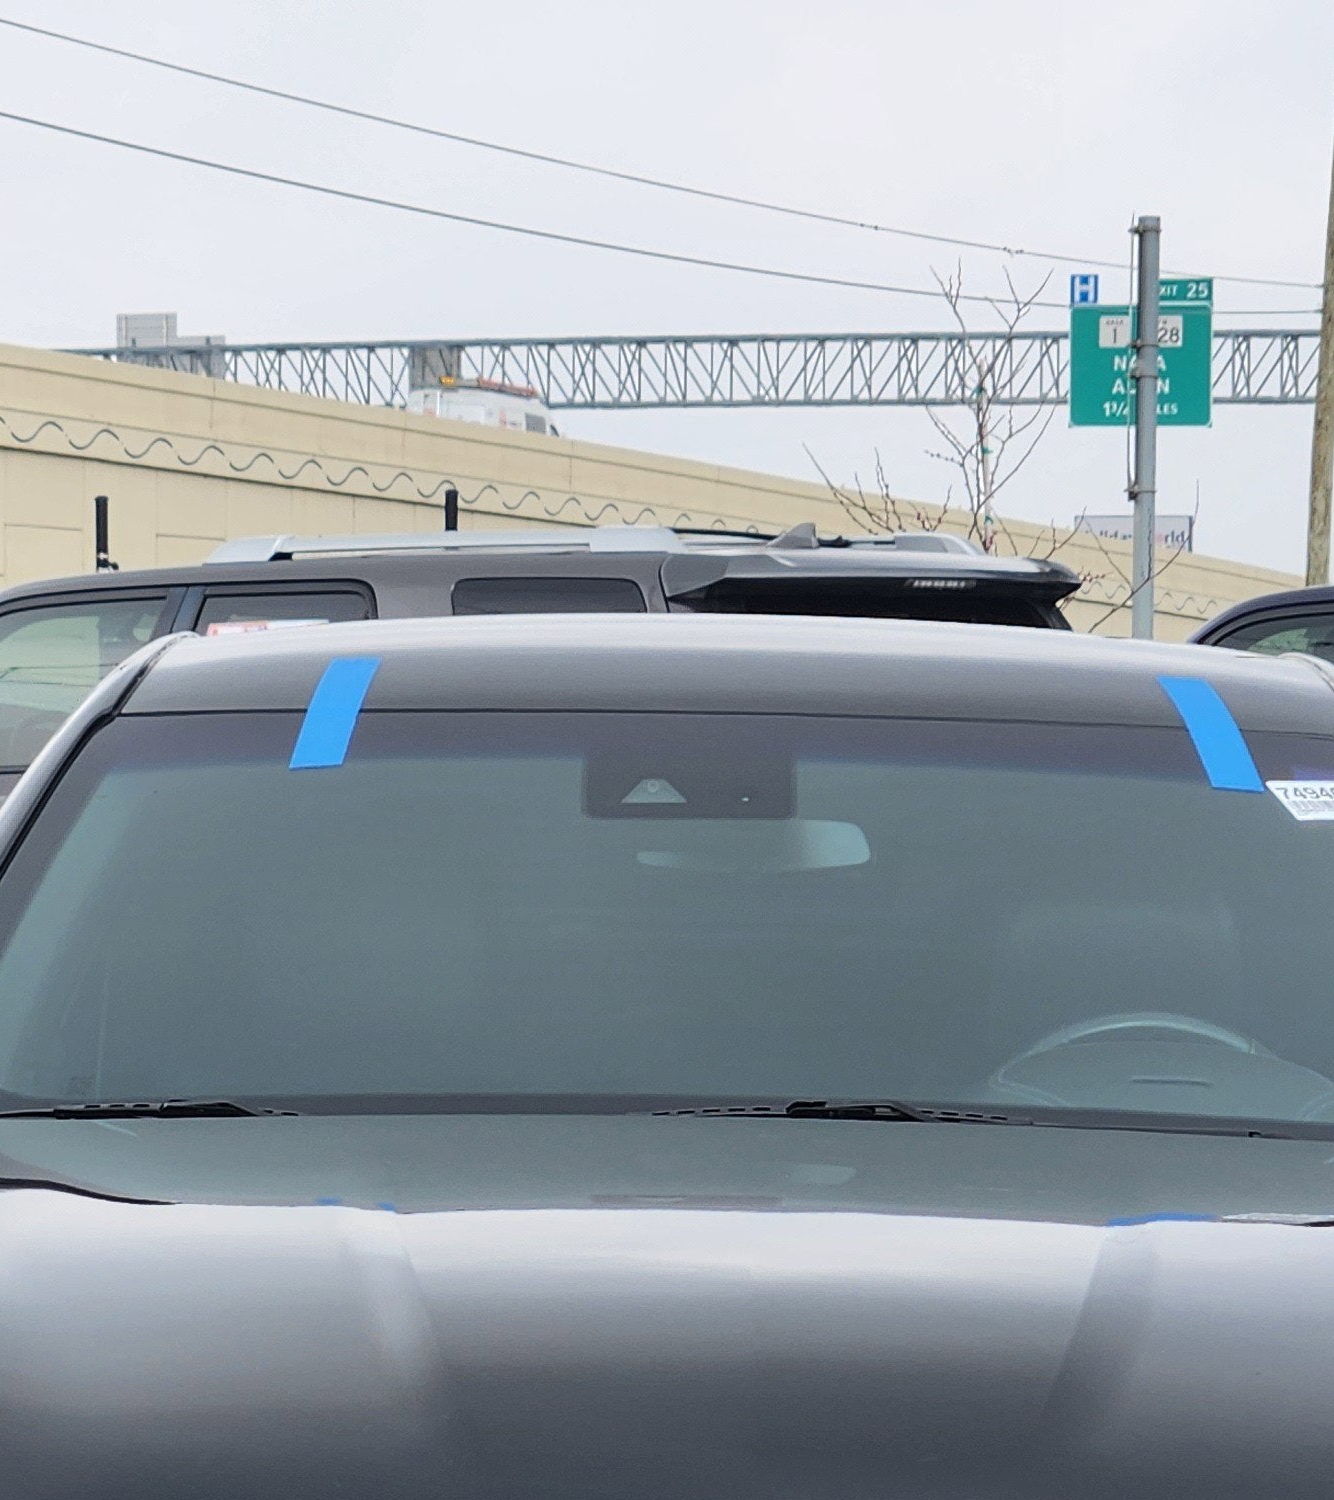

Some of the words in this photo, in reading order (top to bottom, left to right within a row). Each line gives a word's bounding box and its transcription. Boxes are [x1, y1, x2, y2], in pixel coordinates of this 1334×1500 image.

[1157, 285, 1178, 297] XIT
[1186, 282, 1209, 299] 25
[1157, 327, 1180, 344] 28
[1156, 402, 1179, 416] LES
